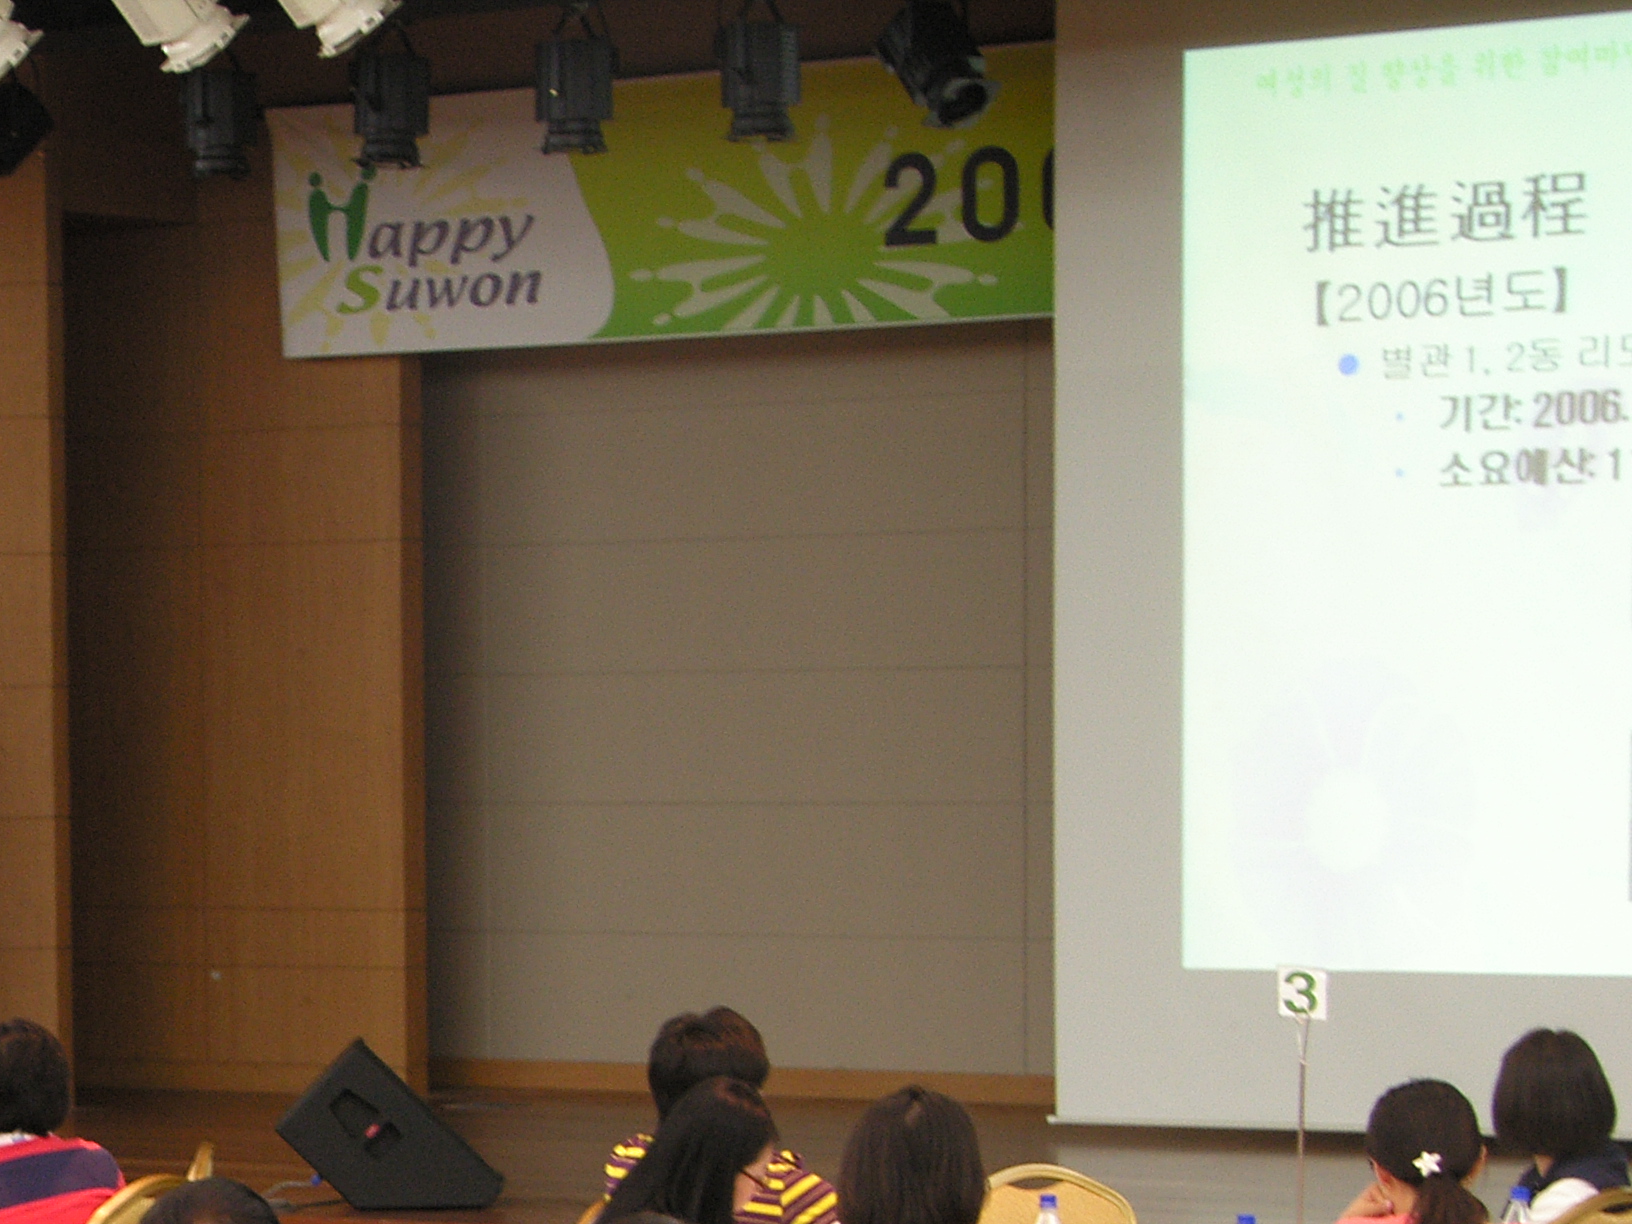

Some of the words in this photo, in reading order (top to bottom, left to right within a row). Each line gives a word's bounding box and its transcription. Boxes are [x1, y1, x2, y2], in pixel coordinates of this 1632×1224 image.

[308, 167, 535, 267] Happy
[1302, 172, 1586, 252] 推進過程
[337, 265, 542, 314] Suwon
[1283, 970, 1318, 1014] 3
